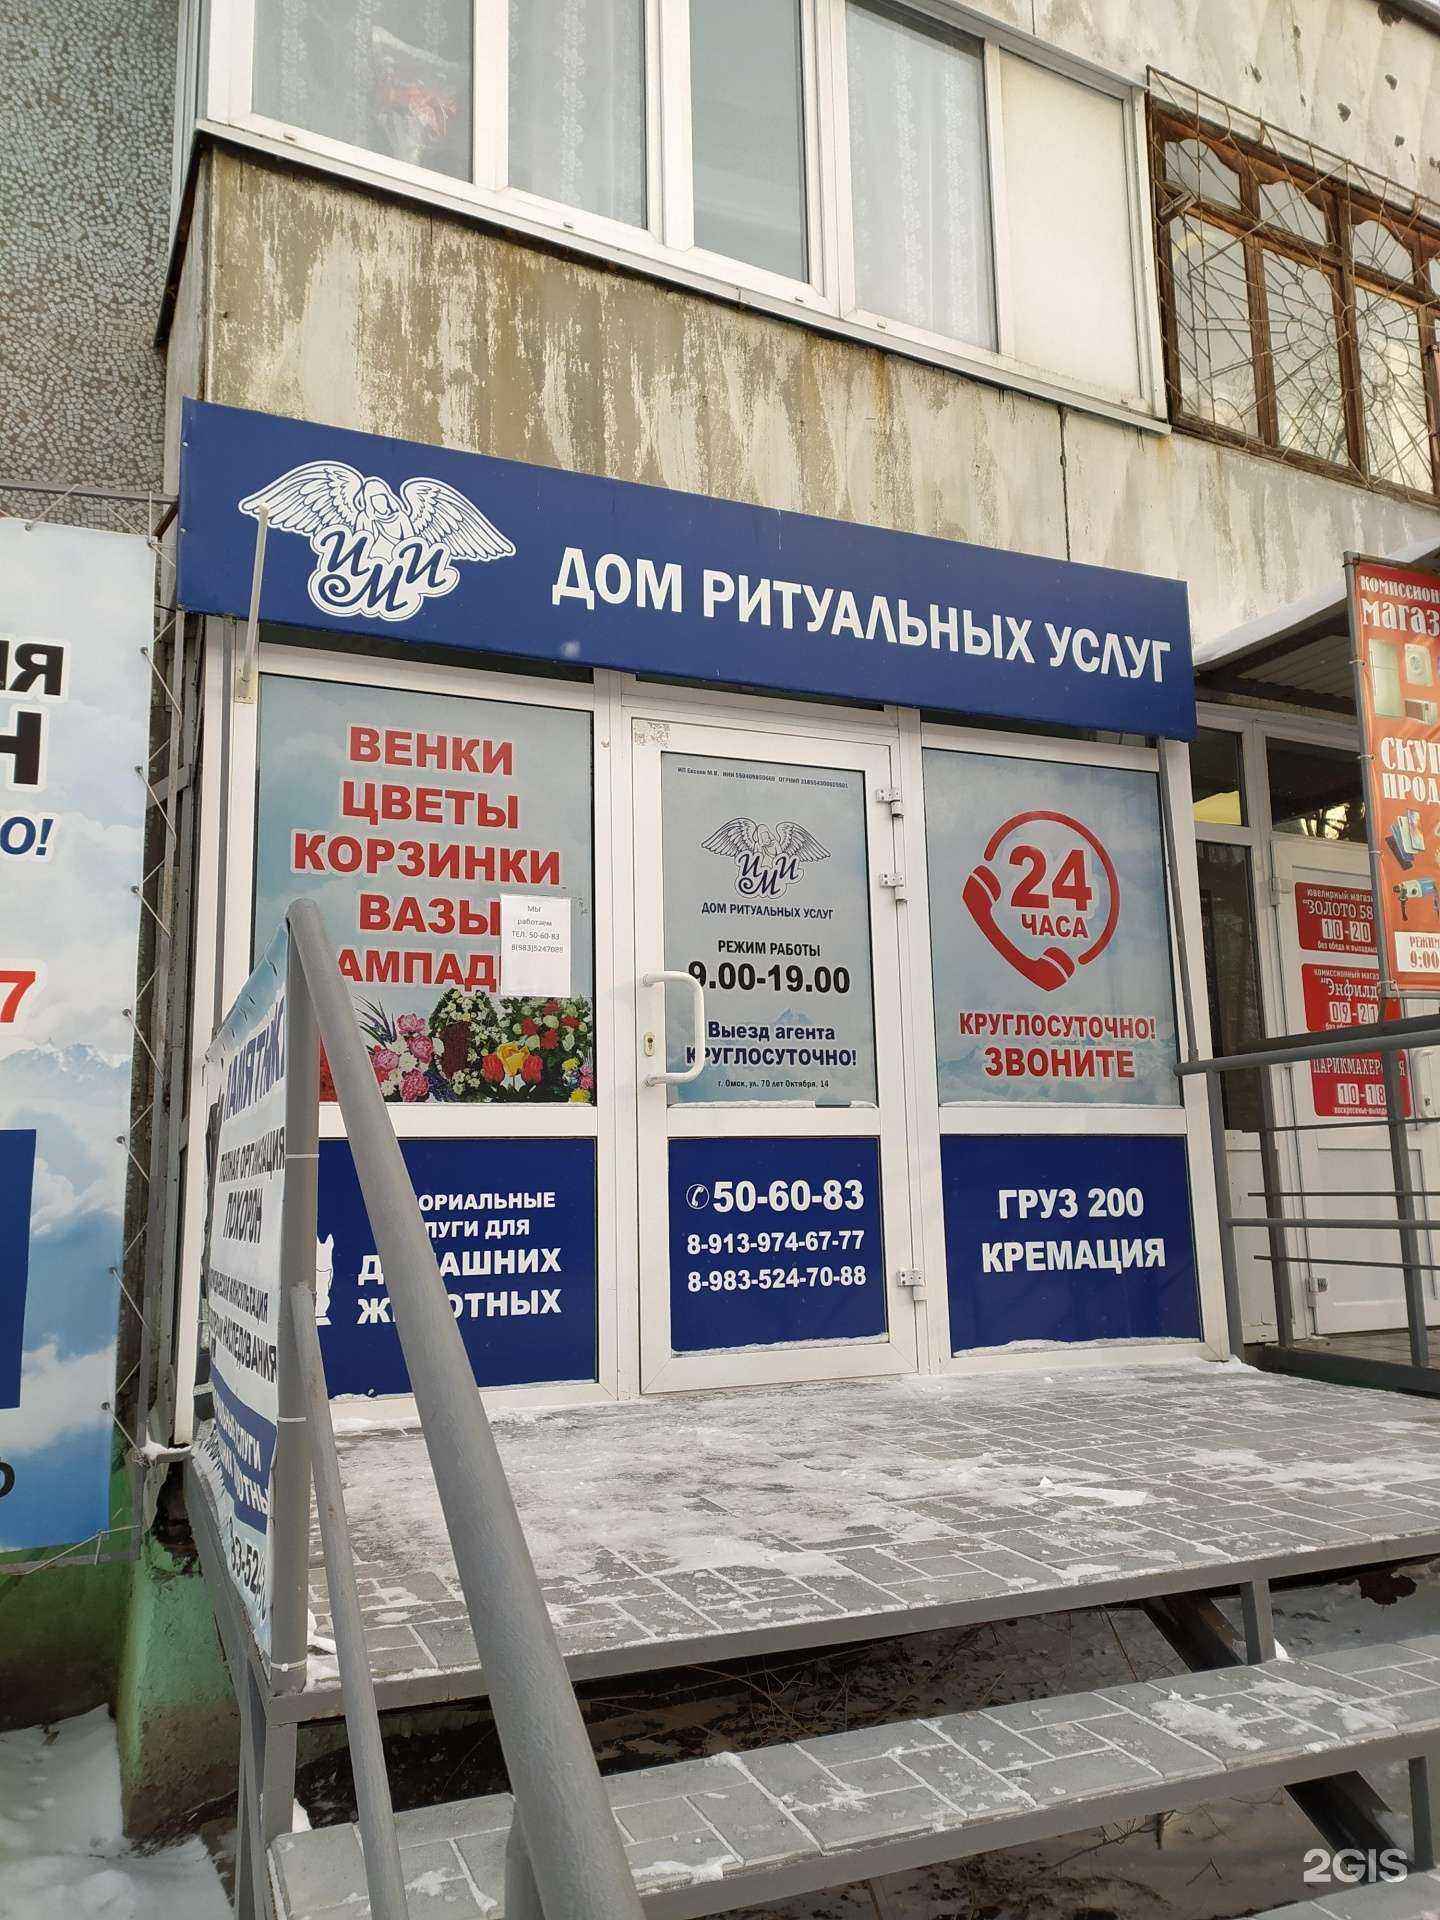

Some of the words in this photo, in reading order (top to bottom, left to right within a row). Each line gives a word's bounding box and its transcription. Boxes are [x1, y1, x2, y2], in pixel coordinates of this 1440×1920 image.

[551, 546, 682, 614] ДОМ
[702, 568, 1036, 664] РИТУАЛЬНЫХ
[1044, 621, 1171, 683] УСЛУГ
[349, 726, 513, 776] ВЕНКИ
[342, 780, 519, 829] ЦВЕТЫ
[294, 832, 560, 886] КОРЗИНКИ
[1008, 845, 1092, 911] 24
[359, 893, 501, 936] ВАЗЫ
[517, 919, 552, 927] работаем
[527, 905, 542, 913] Мы
[701, 902, 727, 915] ДОМ
[729, 904, 801, 918] РИТУАЛЬНЫХ
[803, 907, 834, 920] УСЛУГ
[529, 931, 560, 940] 50-60-83
[1020, 914, 1089, 938] ЧАСА
[718, 940, 766, 954] РЕЖИМ
[770, 942, 821, 957] РАБОТЫ
[337, 948, 502, 993] АМПАД
[688, 960, 850, 994] 9.00-19.00
[1361, 972, 1380, 980] магаз
[708, 1021, 770, 1042] Выезд
[775, 1026, 836, 1040] агента
[959, 1012, 1156, 1039] КРУГЛОСУТОЧНО!
[984, 1047, 1136, 1078] ЗВОНИТЕ
[725, 1080, 748, 1089] Омск,
[749, 1081, 759, 1089] ул.
[761, 1080, 771, 1088] 70
[416, 1191, 556, 1211] ОРИАЛЬНЫЕ
[712, 1179, 865, 1213] 50-60-83
[998, 1187, 1079, 1219] ГРУЗ
[1087, 1187, 1144, 1217] 200
[222, 1187, 263, 1243] ПОХОРОН
[424, 1220, 479, 1239] ЛУГИ
[484, 1218, 530, 1240] ДЛЯ
[687, 1229, 865, 1255] 8-913-974-67-77
[981, 1237, 1166, 1274] КРЕМАЦИЯ
[357, 1247, 562, 1286] ДАШНИХ
[687, 1265, 867, 1292] 8-983-524-70-88
[356, 1288, 562, 1325] ЖОТНЫХ
